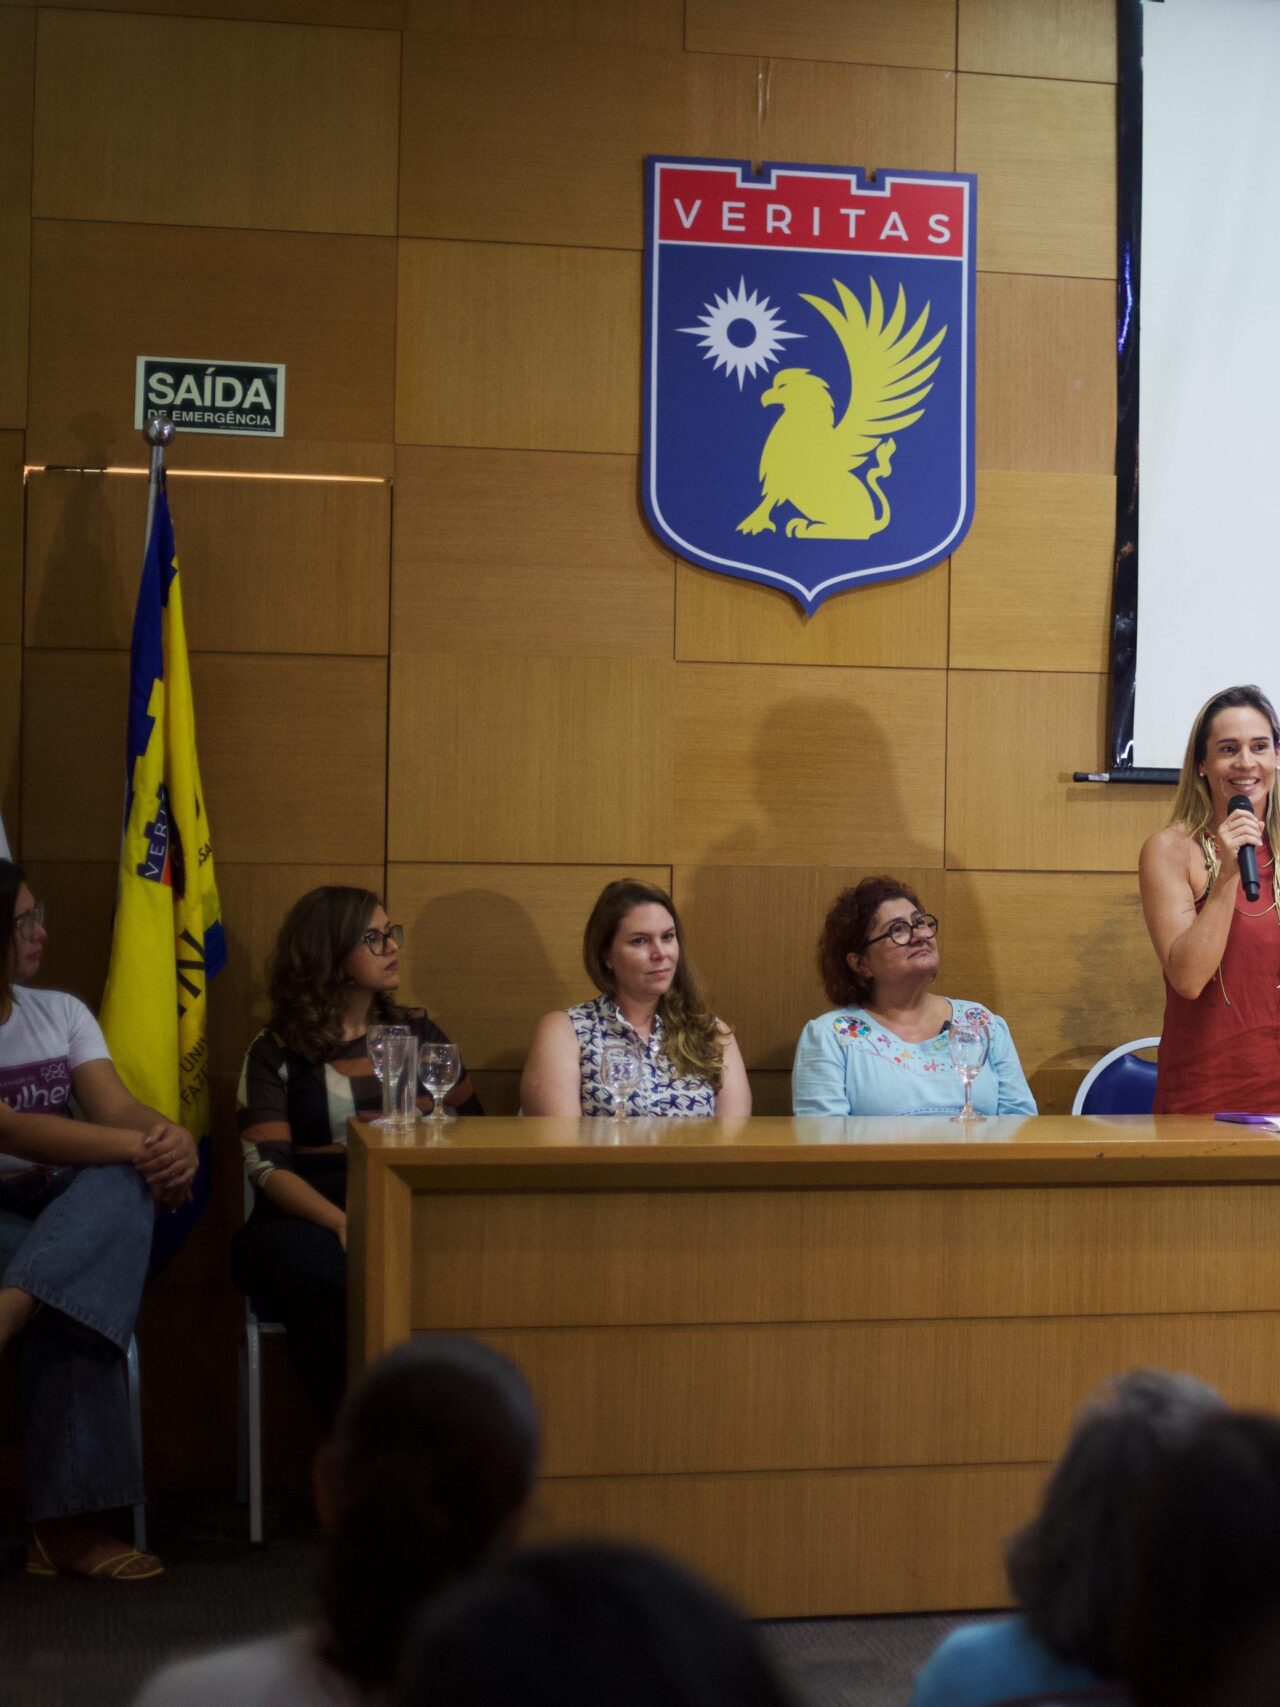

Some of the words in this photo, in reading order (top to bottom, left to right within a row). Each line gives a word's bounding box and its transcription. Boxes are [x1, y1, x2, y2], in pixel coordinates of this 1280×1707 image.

[673, 198, 951, 244] VERITAS
[147, 367, 272, 410] SAÍDA
[172, 411, 271, 426] EMERGÊNCIA
